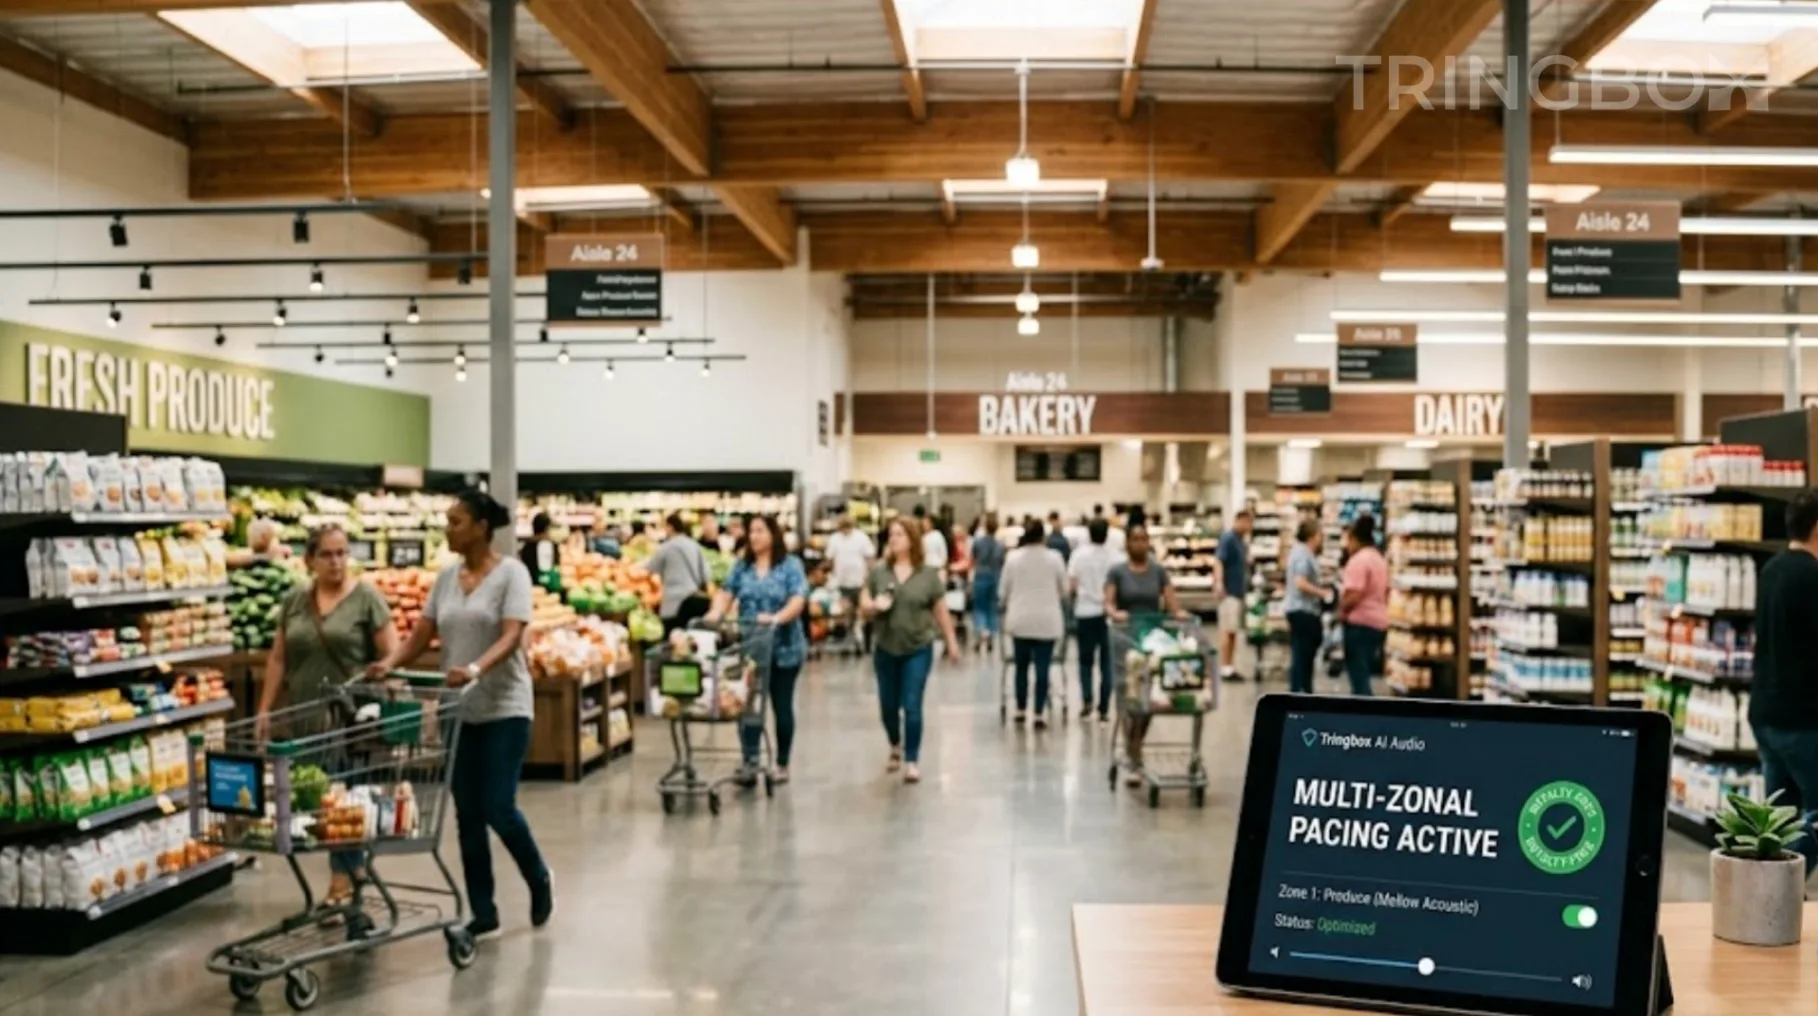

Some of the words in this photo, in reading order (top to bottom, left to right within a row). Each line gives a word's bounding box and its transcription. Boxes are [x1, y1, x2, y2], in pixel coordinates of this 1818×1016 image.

[1575, 211, 1621, 232] Aisle
[1625, 211, 1650, 232] 24
[570, 244, 612, 262] Aisle
[615, 244, 638, 262] 24
[27, 341, 141, 428] FRESH
[147, 360, 275, 440] PRODUCE
[1006, 371, 1043, 391] Aisle
[979, 394, 1097, 436] BAKERY
[1415, 394, 1505, 435] DAIRY
[1320, 732, 1371, 750] Tringbox
[1374, 735, 1387, 749] AI
[1389, 736, 1425, 751] Audio
[1293, 778, 1478, 817] MULTI-ZONAL
[1288, 816, 1390, 850] PACING
[1396, 824, 1499, 858] ACTIVE
[1278, 883, 1308, 900] Zone
[1310, 886, 1320, 901] 1:
[1323, 887, 1371, 905] Produce
[1373, 891, 1420, 909] (Mellow
[1422, 897, 1479, 917] Acoustic)
[1274, 913, 1314, 930] Status:
[1317, 916, 1376, 935] Optimized
